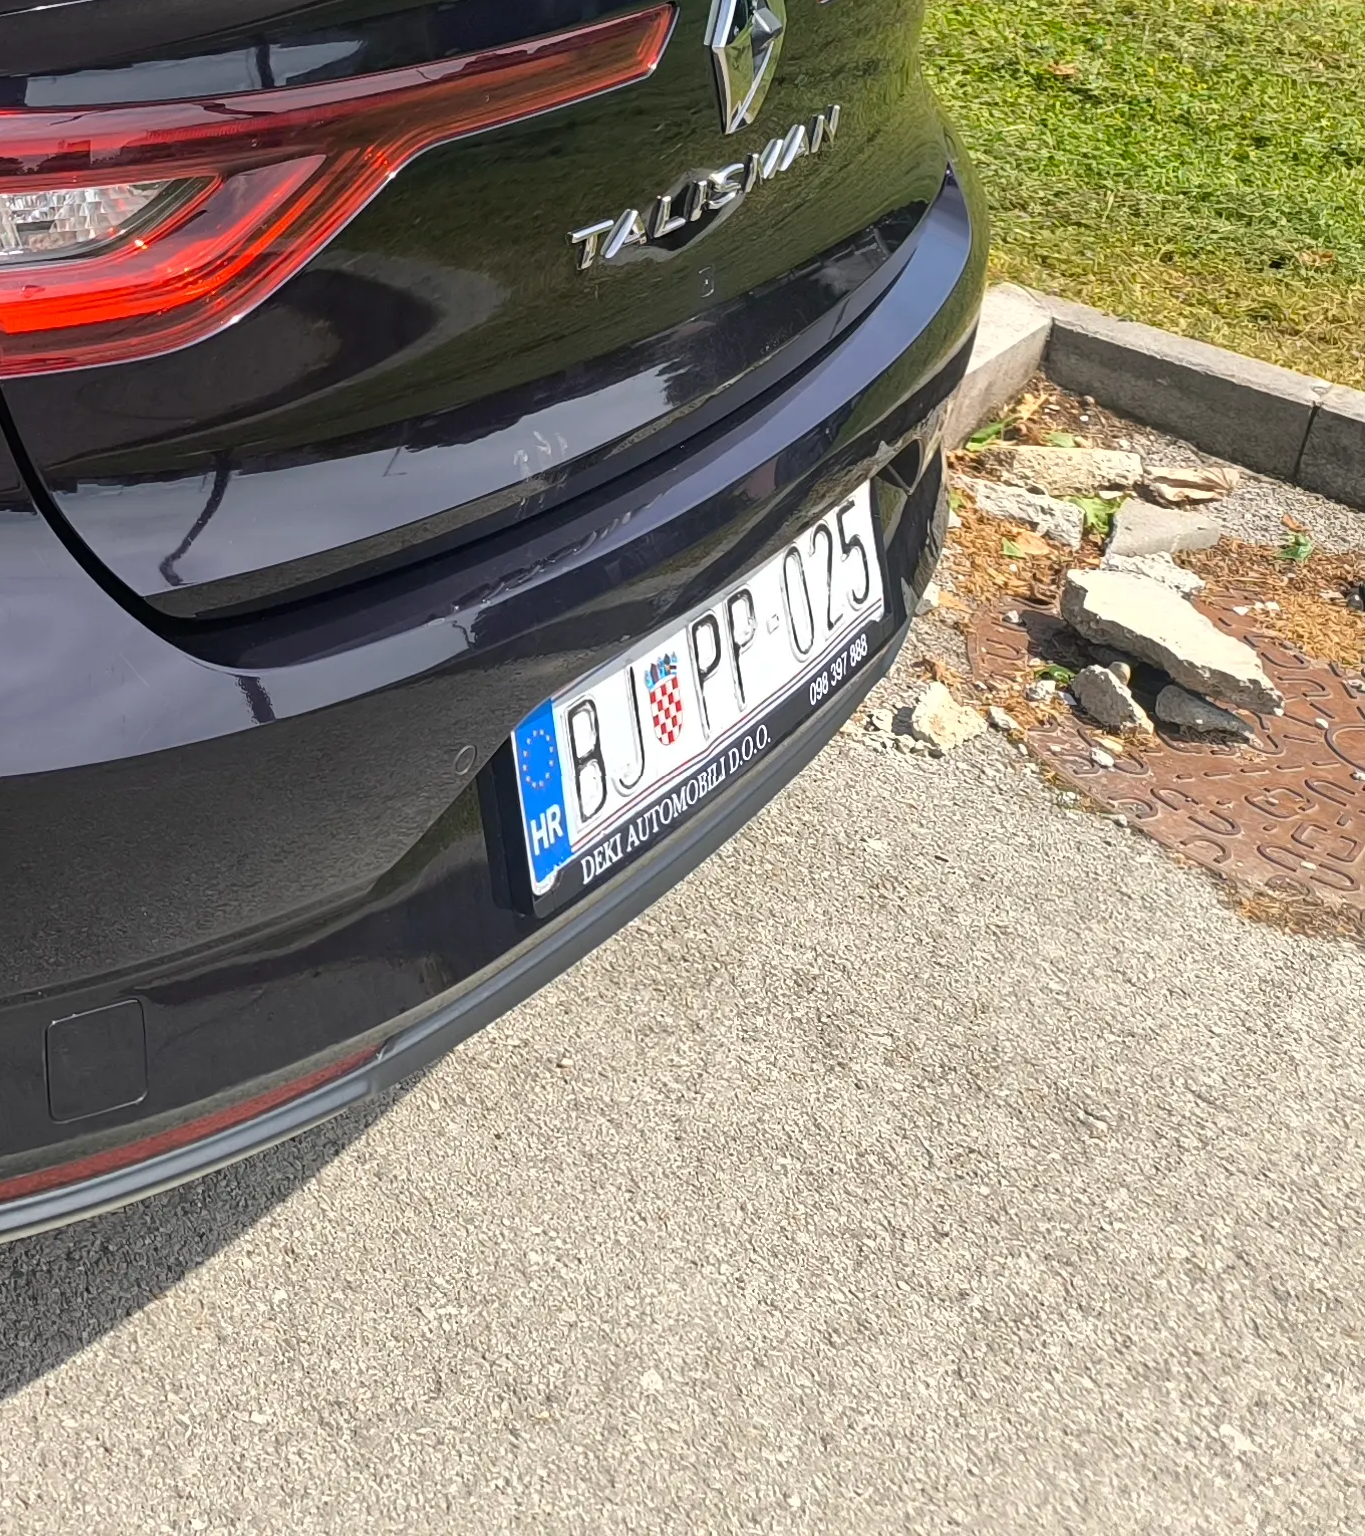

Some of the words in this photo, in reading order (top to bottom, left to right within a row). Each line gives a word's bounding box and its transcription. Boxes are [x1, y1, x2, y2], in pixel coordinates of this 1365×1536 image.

[566, 104, 841, 271] TALISMAN
[565, 664, 646, 825] BJ
[809, 671, 829, 706] 098
[830, 650, 848, 687] 397
[849, 632, 869, 668] 888
[529, 803, 564, 856] HR
[580, 831, 623, 885] DEKI
[626, 758, 727, 853] AUTOMOBILI
[729, 724, 772, 774] D.O.O.
